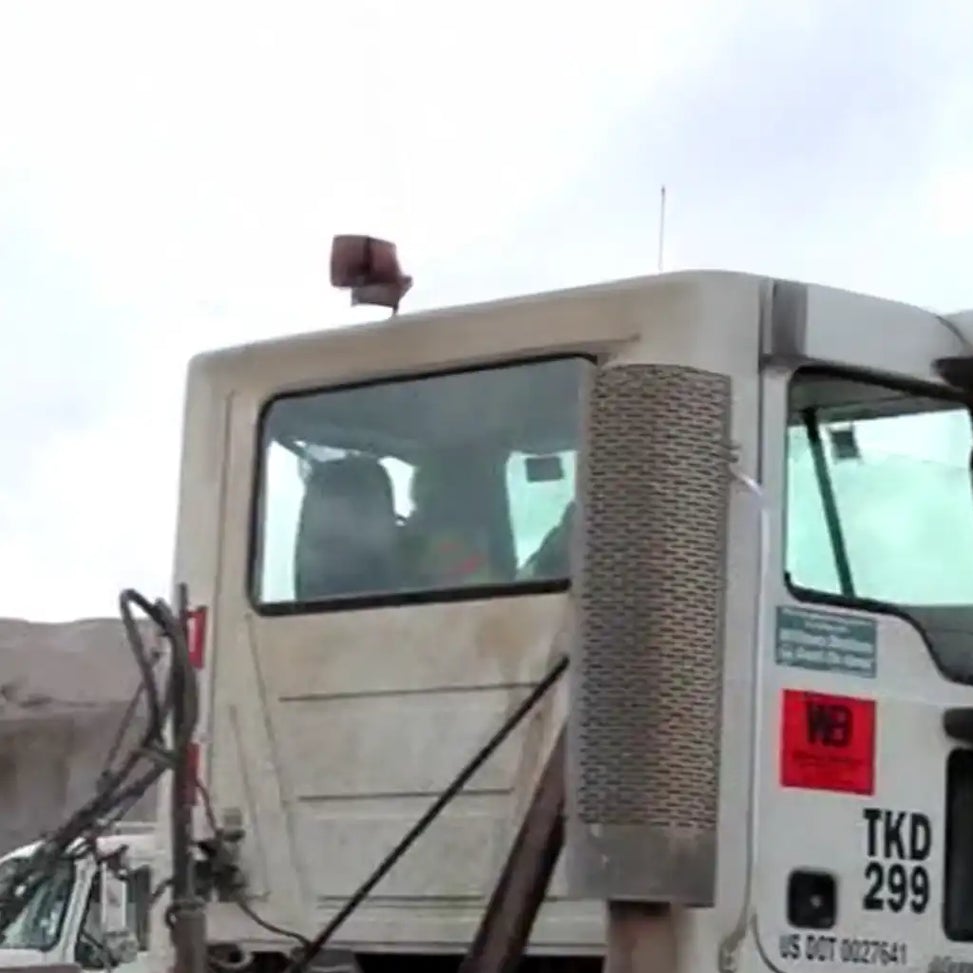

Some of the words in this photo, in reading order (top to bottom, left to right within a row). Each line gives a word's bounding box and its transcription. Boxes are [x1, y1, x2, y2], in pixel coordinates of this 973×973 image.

[863, 808, 932, 861] TKD
[863, 861, 930, 915] 299
[779, 934, 800, 960] US
[806, 935, 836, 961] DOT
